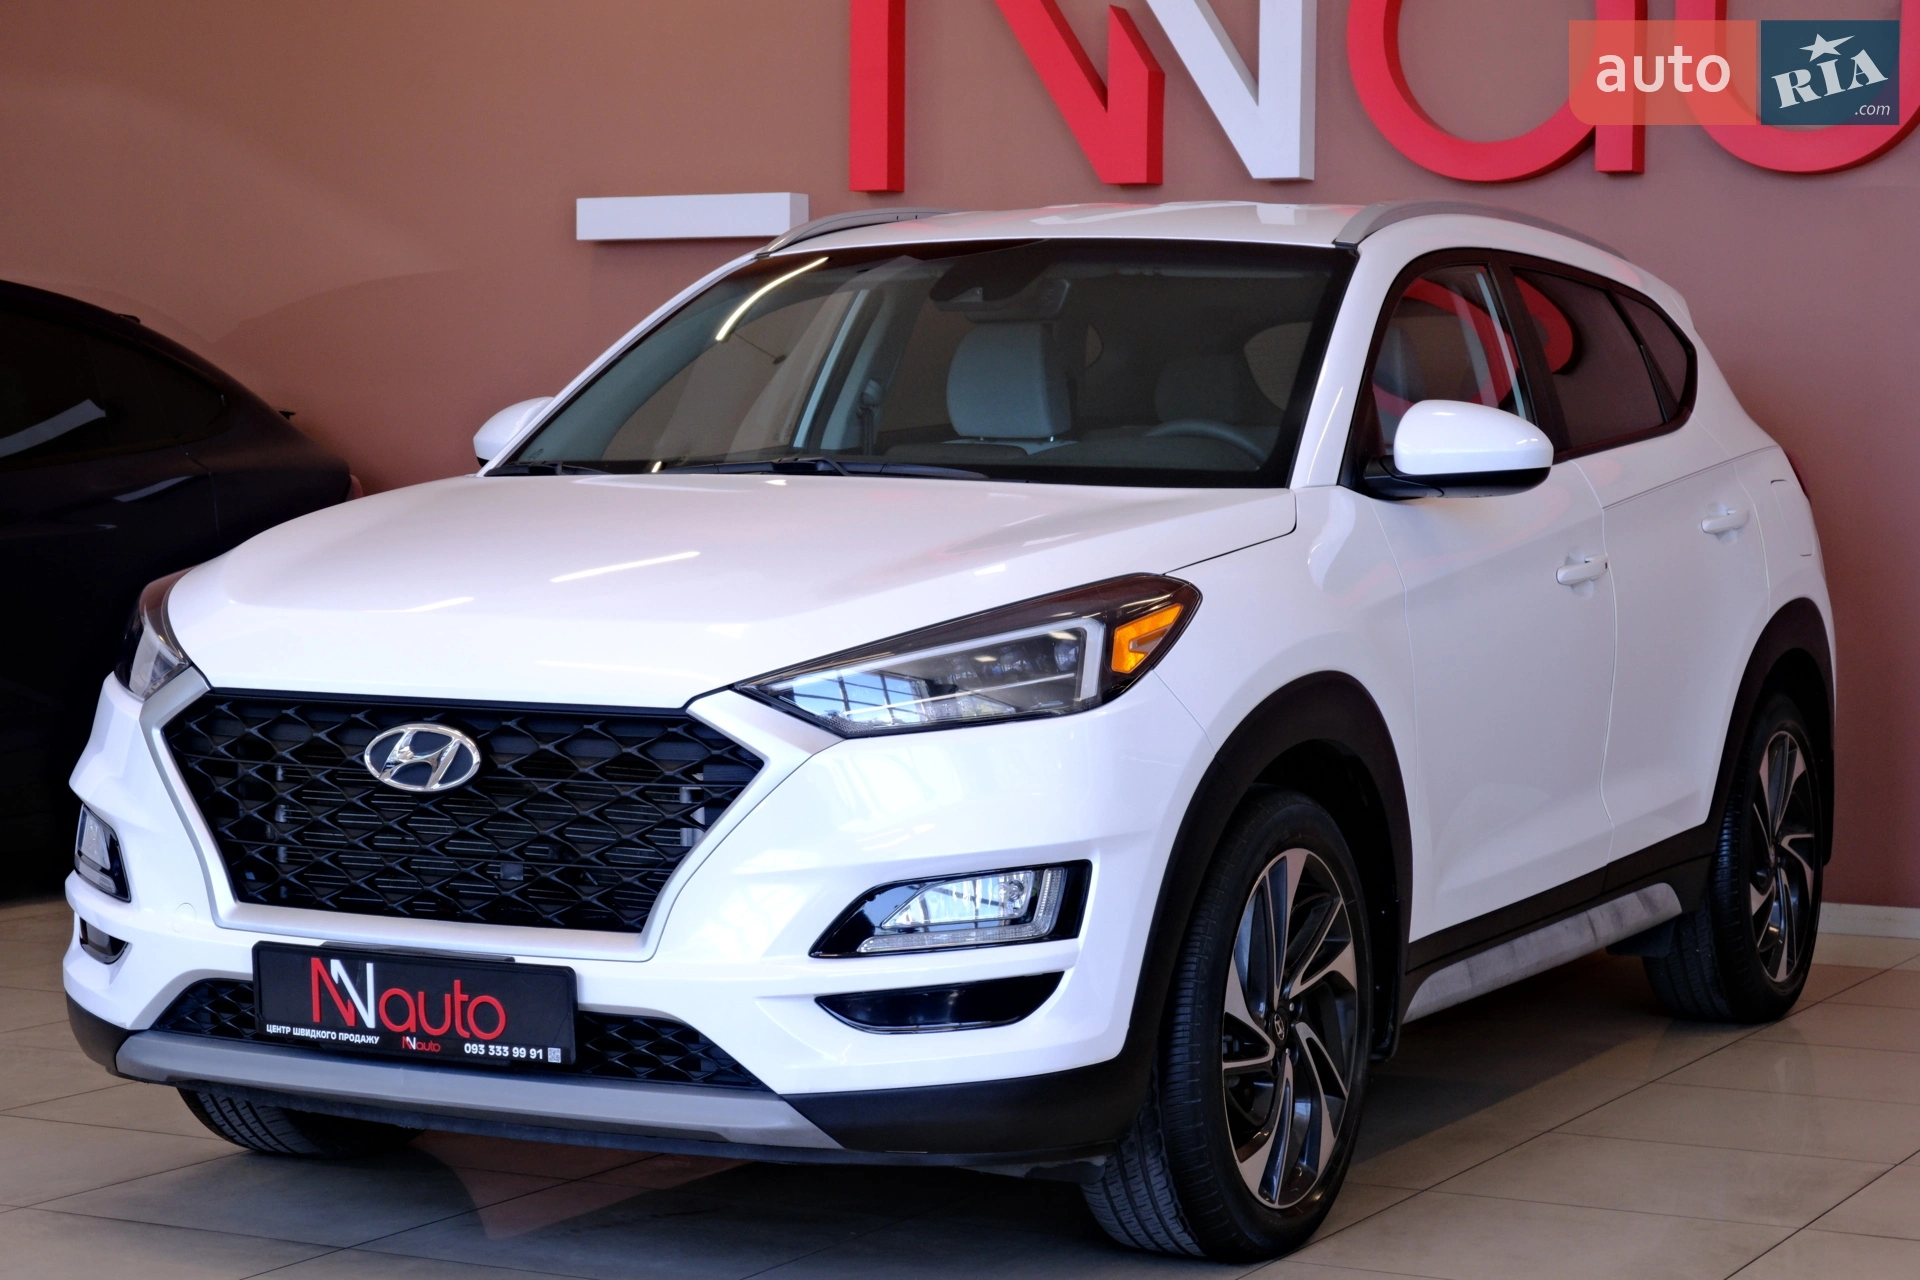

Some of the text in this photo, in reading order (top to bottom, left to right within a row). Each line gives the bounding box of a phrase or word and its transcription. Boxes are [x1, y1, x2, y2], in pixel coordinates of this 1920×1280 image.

[310, 957, 507, 1040] NNauto
[266, 1024, 380, 1044] ЦЕНТР ШВИДКОГО ПРОДАЖУ
[464, 1043, 543, 1060] 093 333 99 91
